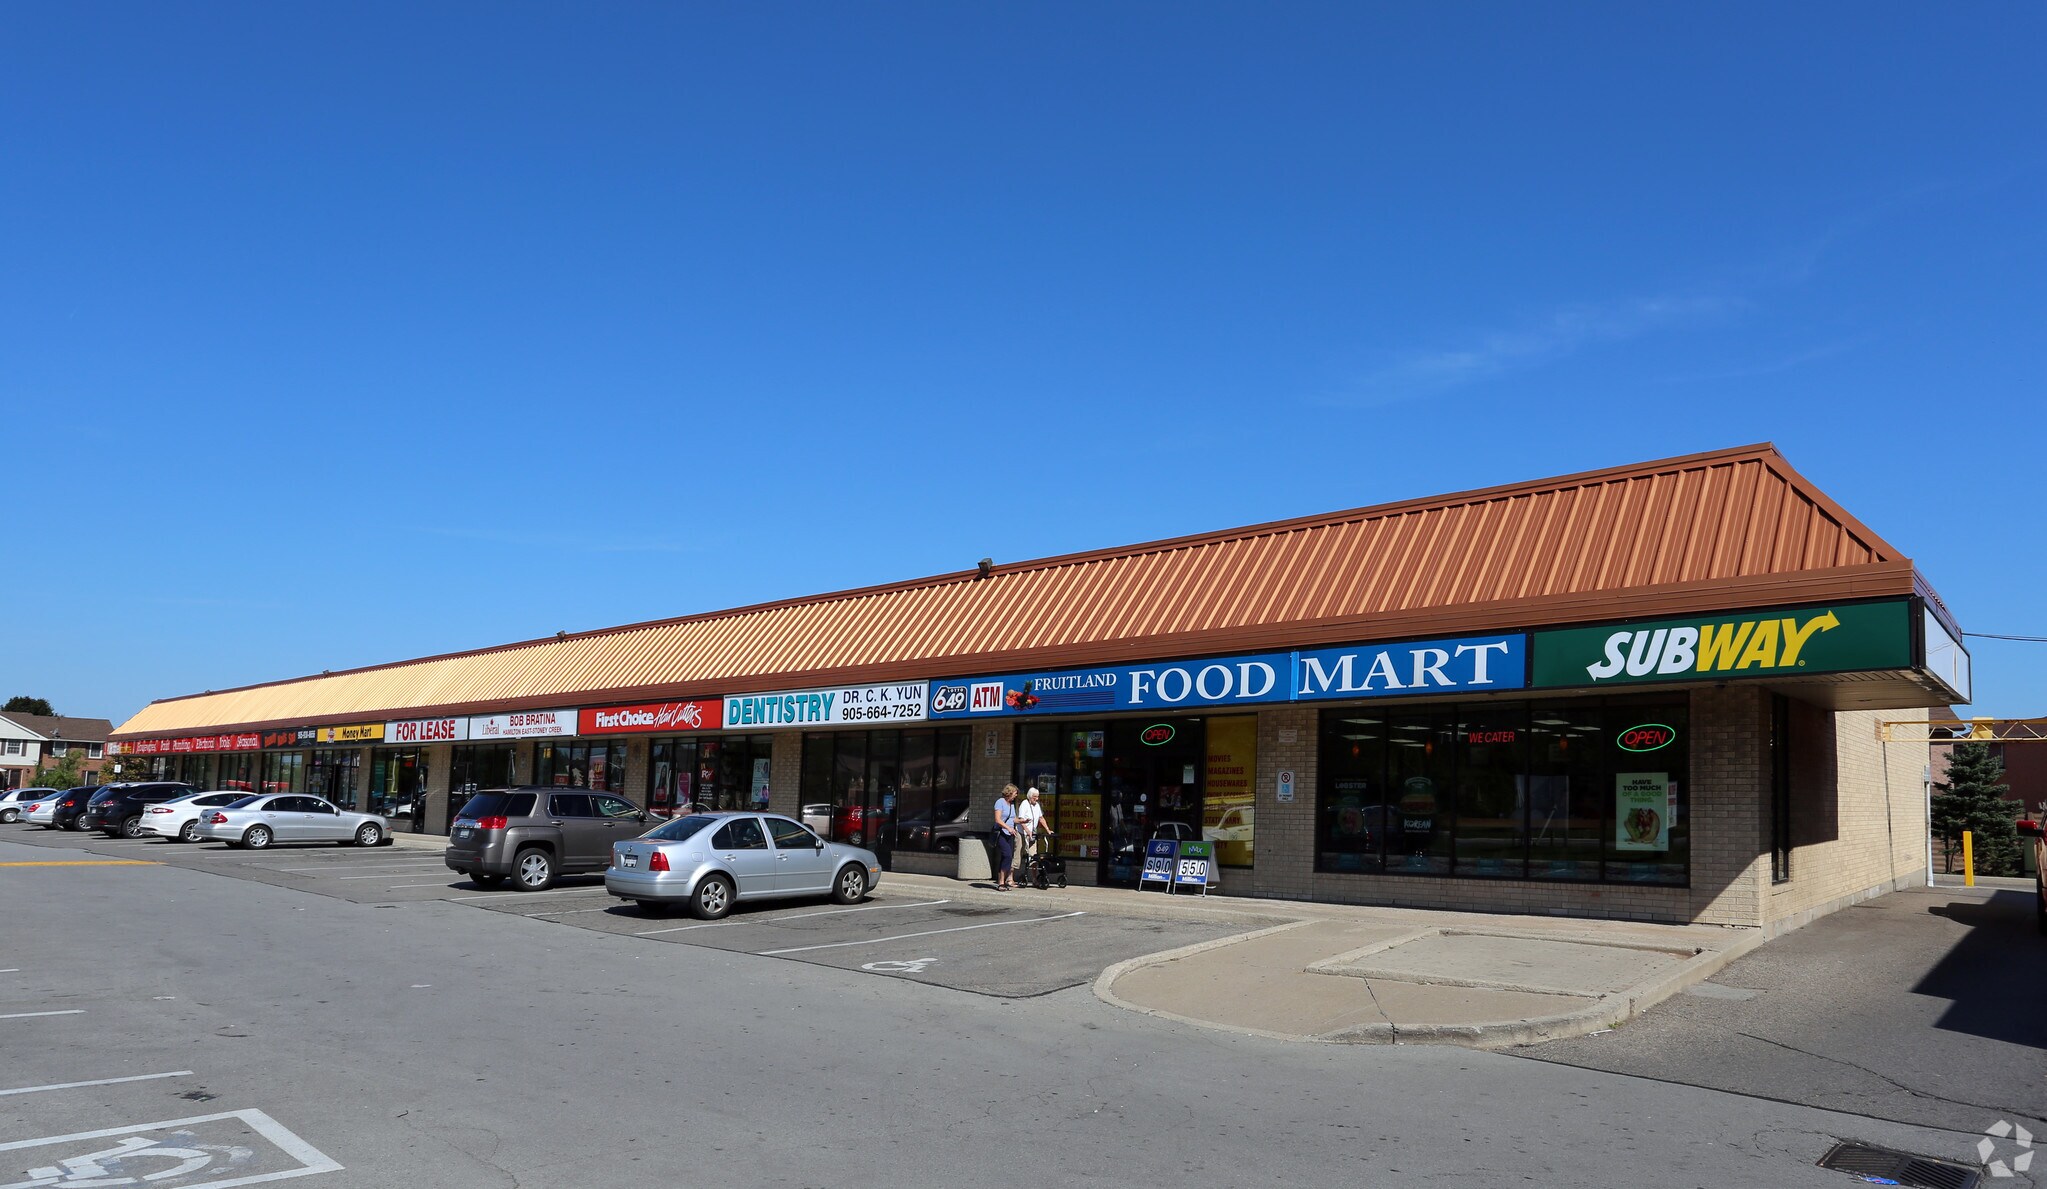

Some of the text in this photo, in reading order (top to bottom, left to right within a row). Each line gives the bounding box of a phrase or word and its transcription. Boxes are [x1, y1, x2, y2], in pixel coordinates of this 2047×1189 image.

[1585, 610, 1840, 681] SUBWAY
[1128, 640, 1509, 704] FOOD MART
[1034, 673, 1117, 691] FRUITLAND
[843, 686, 922, 703] DR. C. K. YUN
[933, 686, 964, 711] 649
[972, 685, 1001, 708] ATM
[728, 692, 836, 725] DENTISTRY
[842, 703, 921, 721] 905-664-7252
[509, 713, 556, 727] BOB BRATINA
[342, 727, 359, 741] Money
[360, 726, 372, 738] Mart
[396, 719, 456, 741] FOR LEASE
[482, 724, 500, 736] Liberal
[1145, 729, 1170, 741] OPEN
[1469, 731, 1515, 743] WE CATER
[236, 734, 258, 748] Seasonal
[1624, 731, 1666, 745] OPEN
[1207, 754, 1231, 762] MOVIES
[1207, 767, 1244, 775] MAGAZINES
[1207, 779, 1248, 787] HOUSEWARES
[1403, 818, 1432, 829] KOREAN
